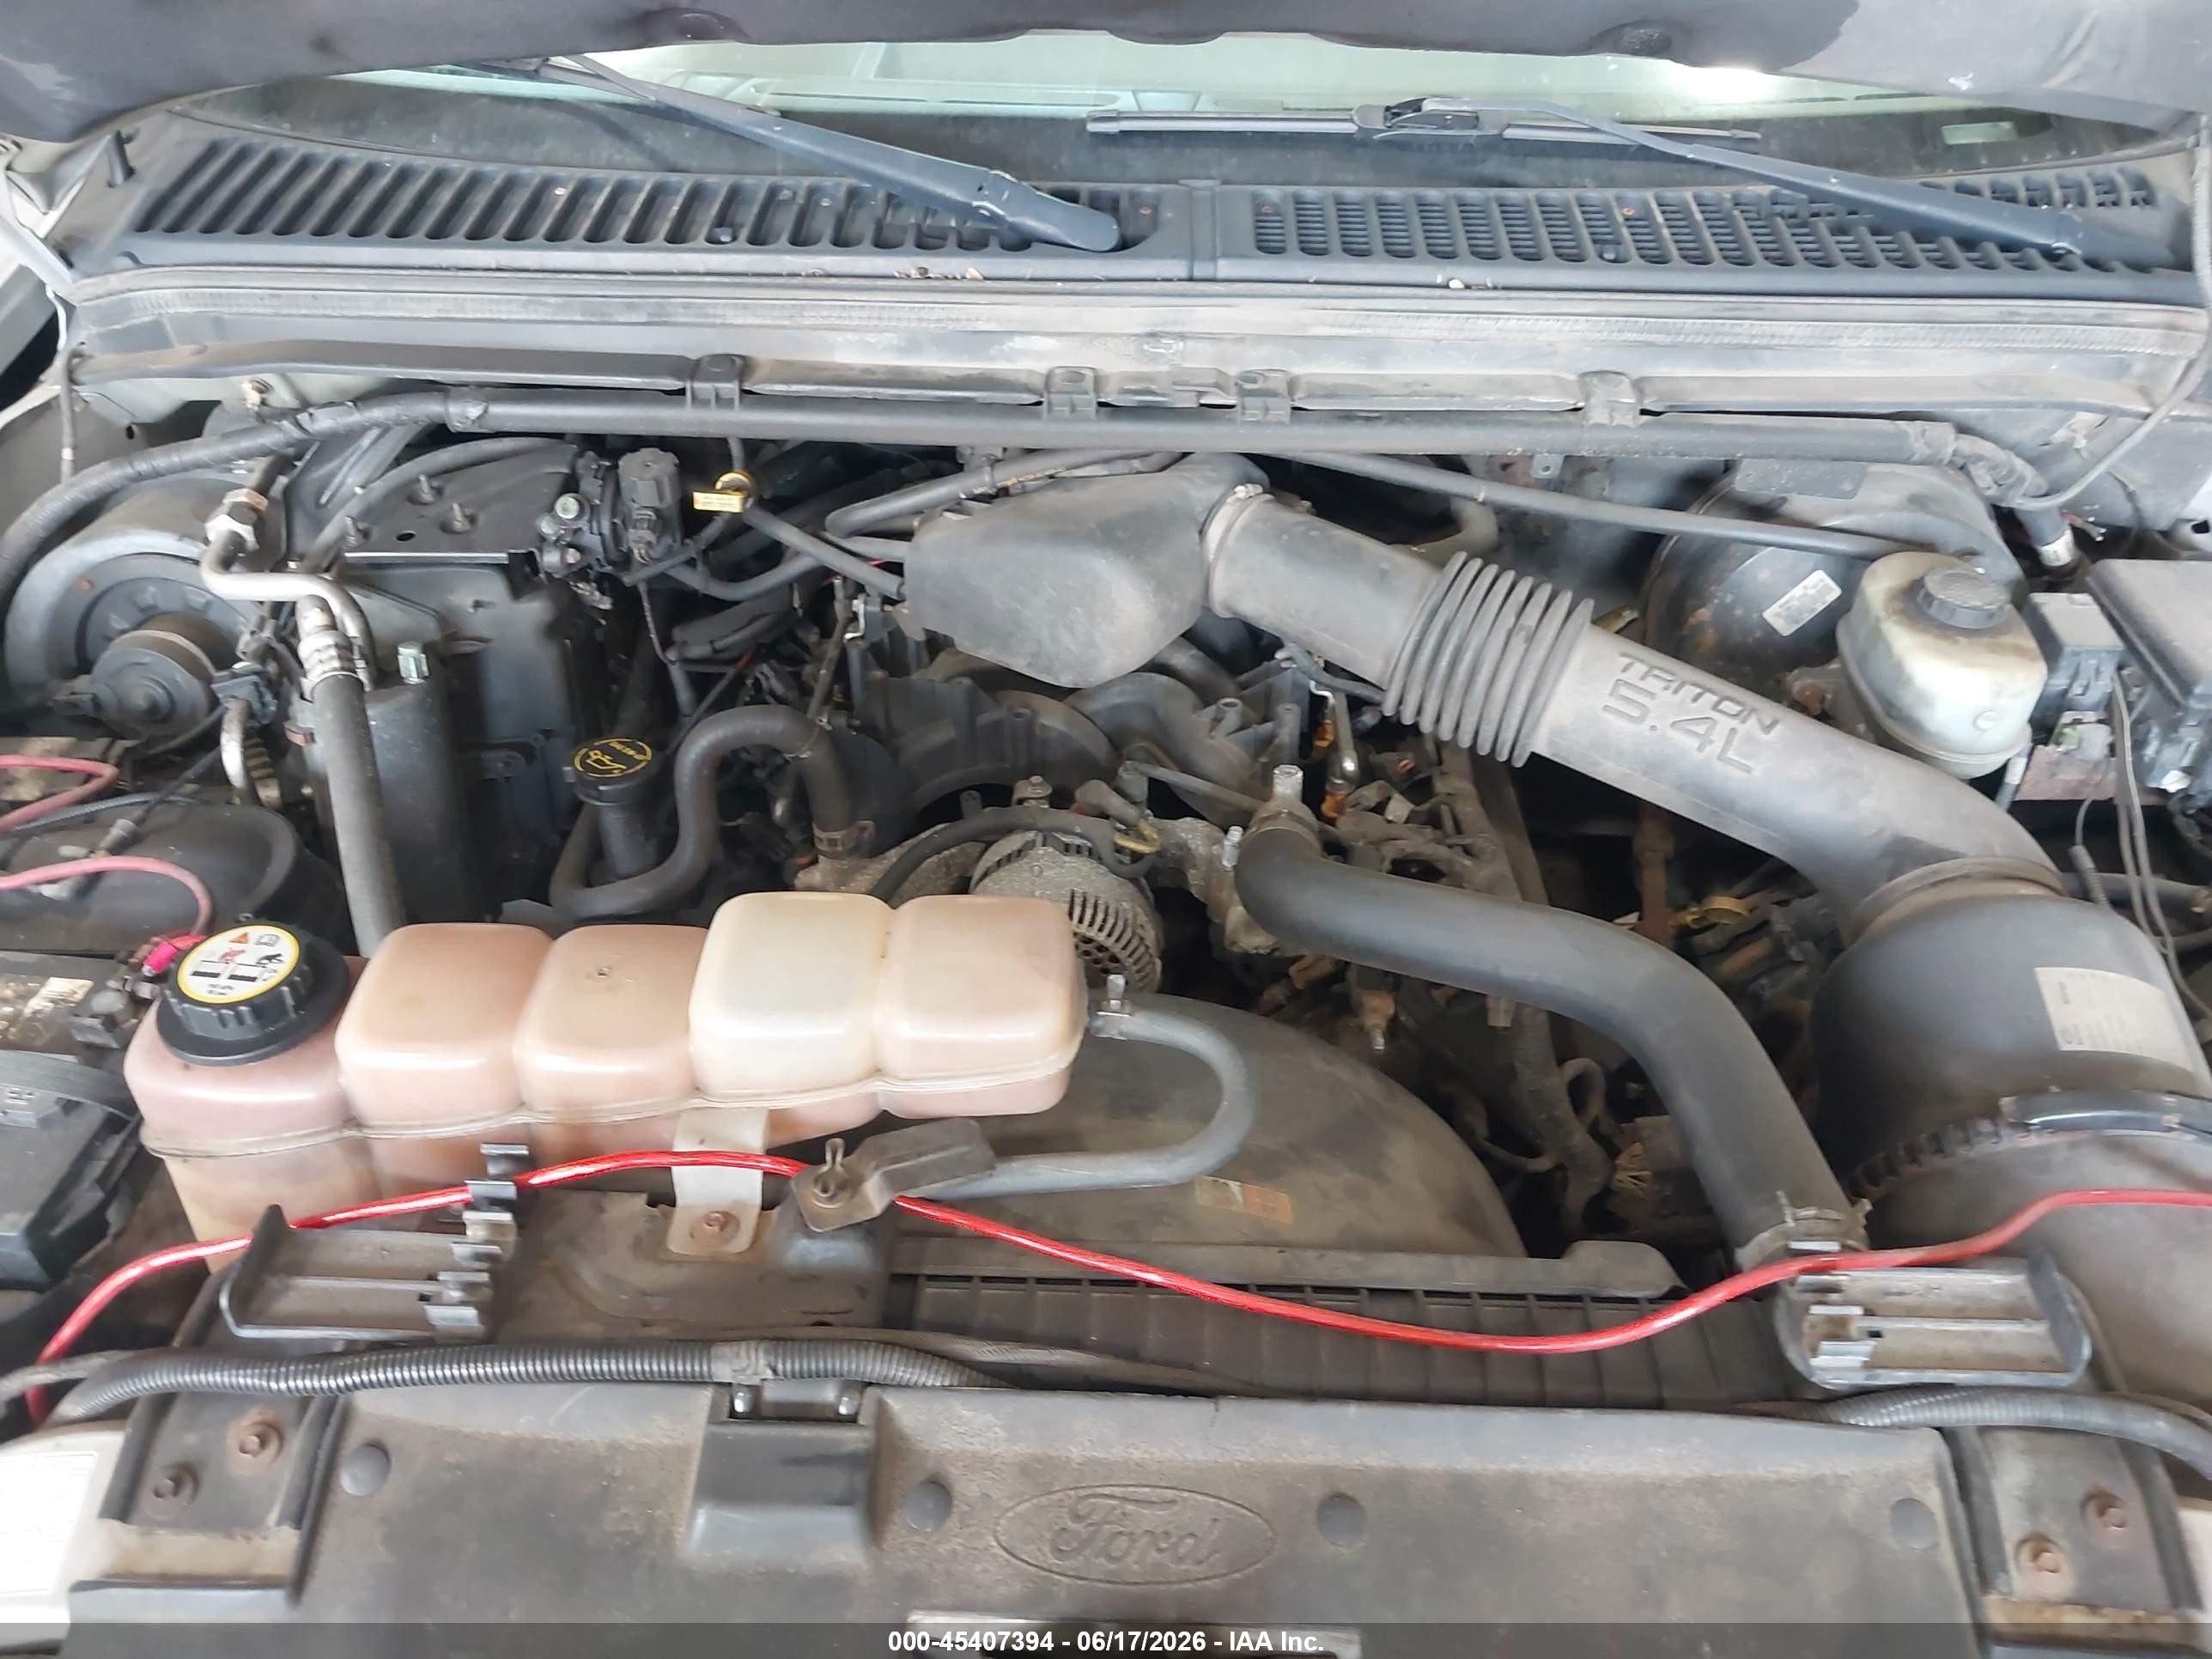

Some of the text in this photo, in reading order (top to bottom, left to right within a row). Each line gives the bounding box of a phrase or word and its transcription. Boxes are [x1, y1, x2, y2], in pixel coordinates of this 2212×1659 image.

[1601, 678, 1753, 774] 5.4L
[1619, 652, 1780, 735] TRITON
[1049, 1492, 1223, 1570] Ford
